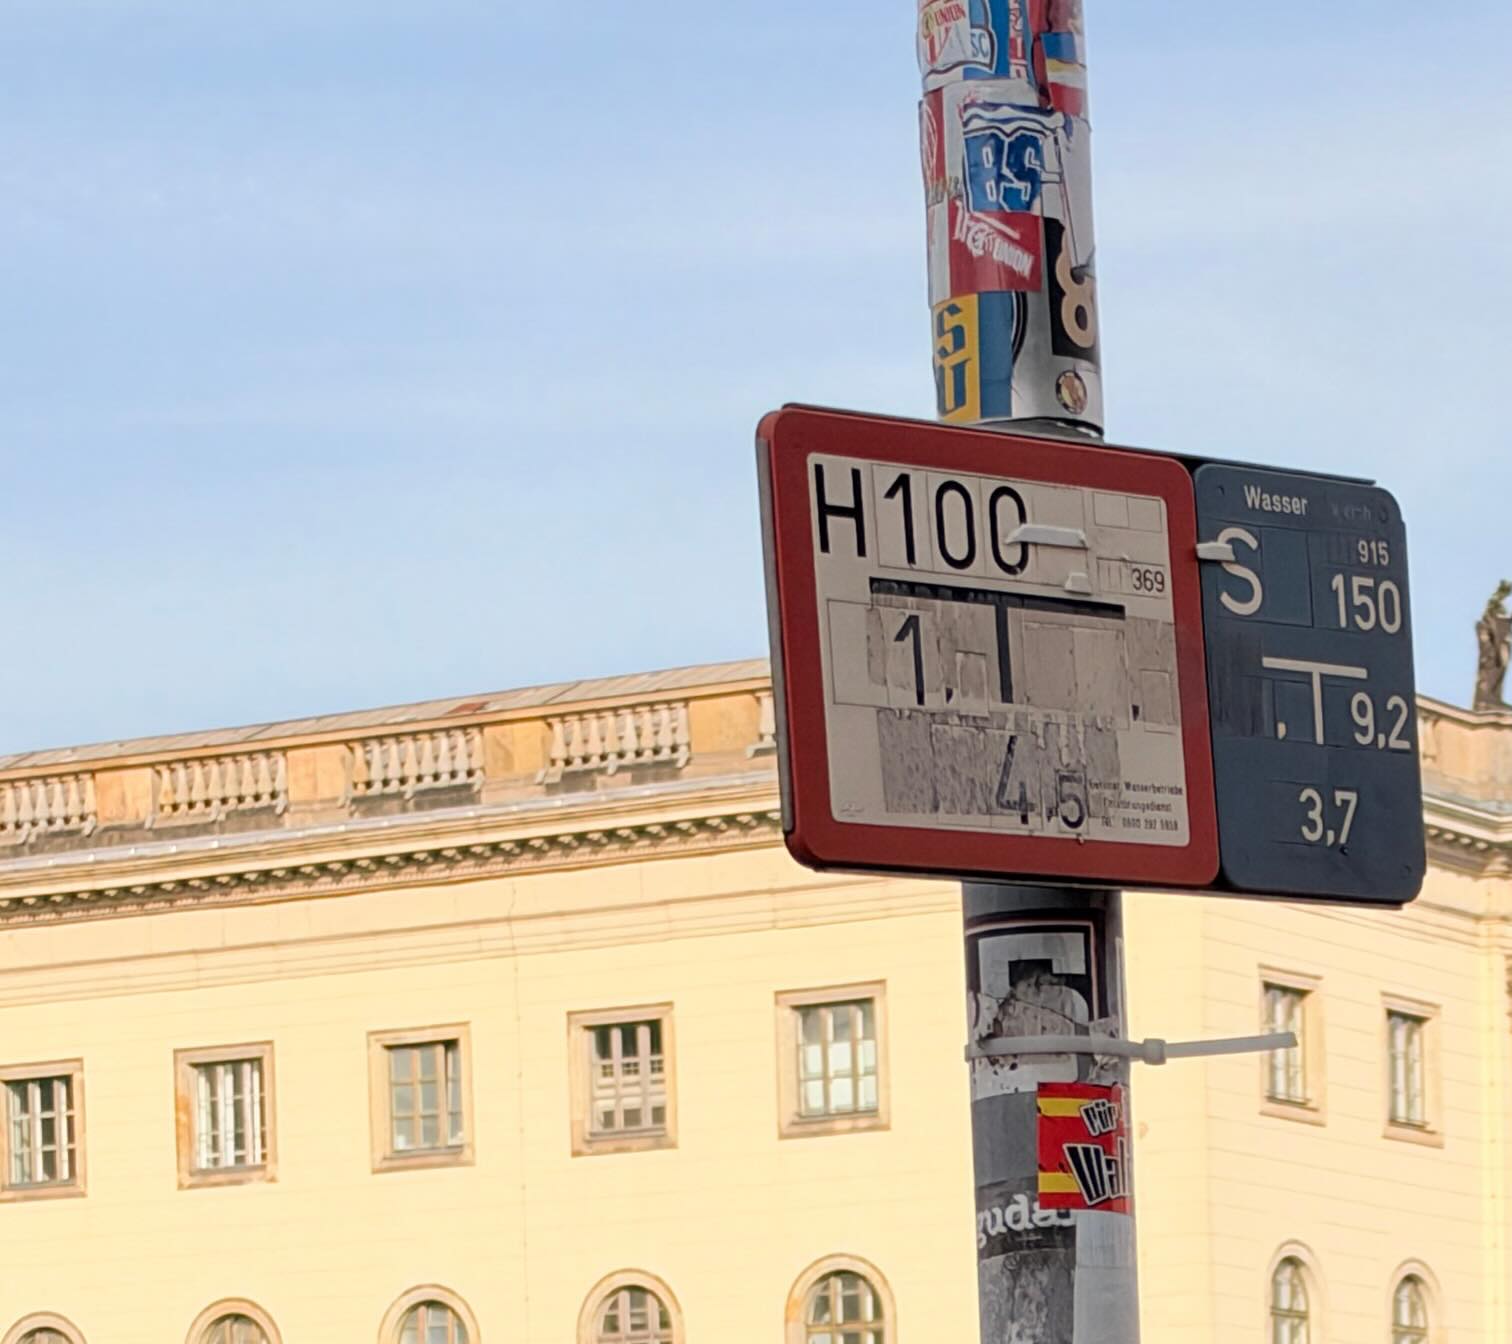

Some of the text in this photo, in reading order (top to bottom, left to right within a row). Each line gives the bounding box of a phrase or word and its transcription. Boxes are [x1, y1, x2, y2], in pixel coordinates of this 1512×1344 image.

[814, 463, 1029, 575] H100
[1243, 484, 1308, 516] Wasser
[1131, 567, 1165, 593] 369
[1217, 526, 1402, 634] S 150
[1357, 539, 1390, 566] 915
[1350, 691, 1411, 750] 9,2
[1299, 787, 1359, 848] 3,7
